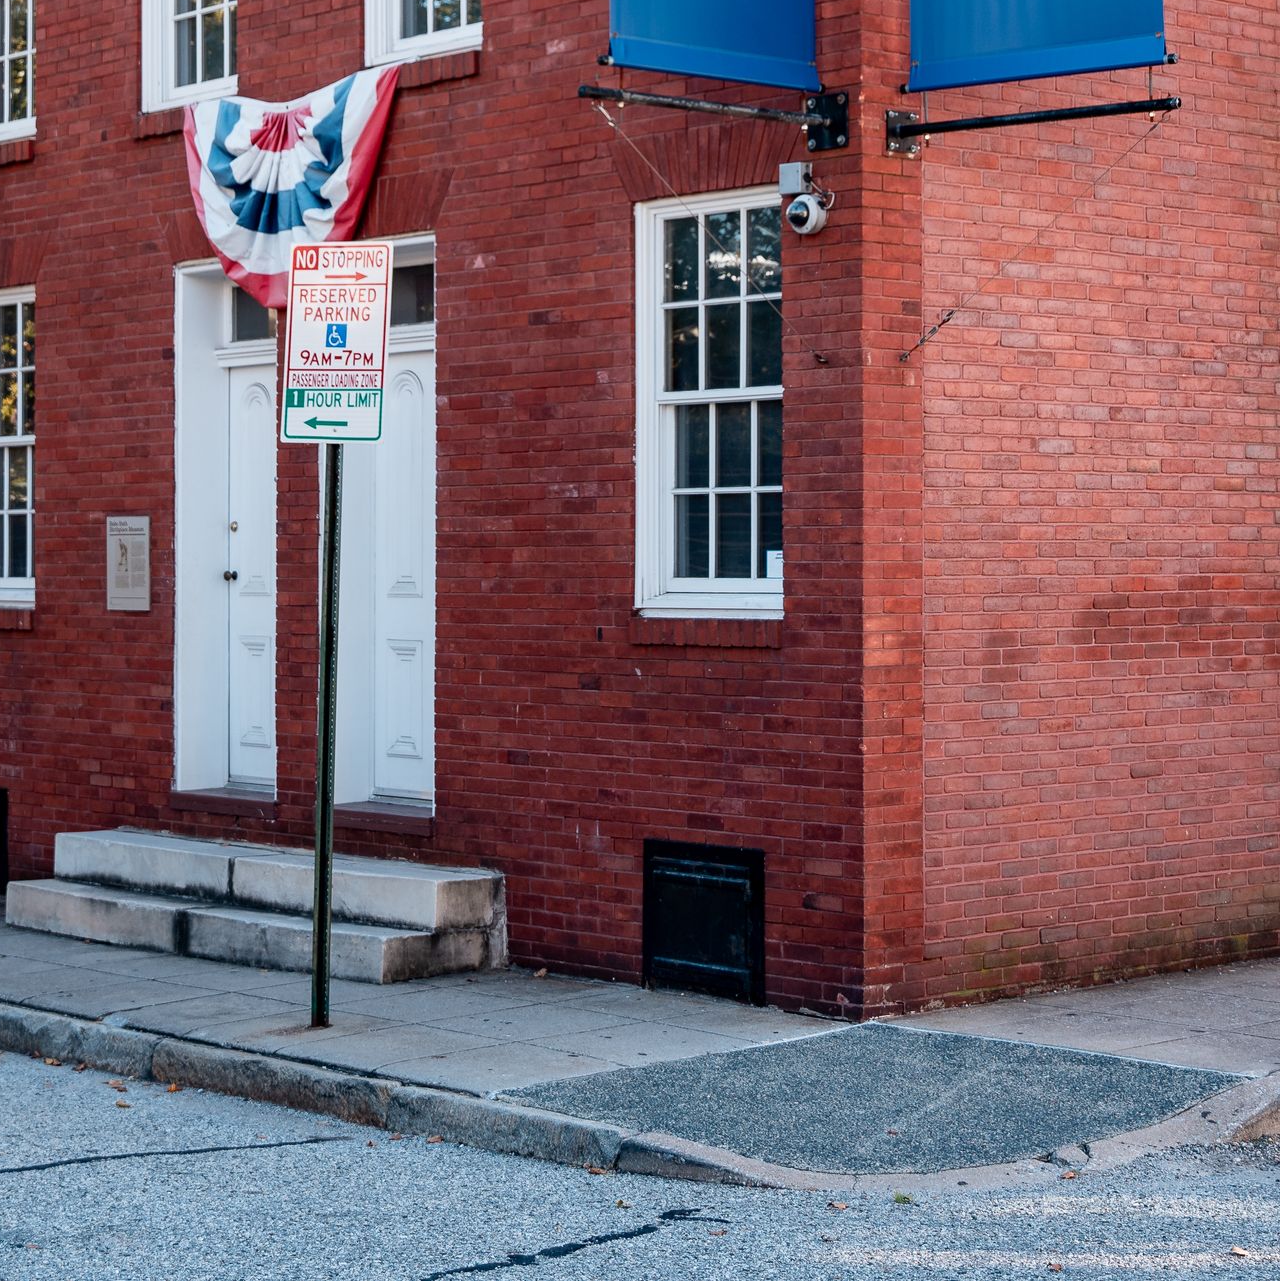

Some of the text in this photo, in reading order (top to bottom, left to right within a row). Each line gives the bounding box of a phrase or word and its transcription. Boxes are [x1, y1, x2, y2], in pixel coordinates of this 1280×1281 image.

[296, 249, 383, 269] NO STOPPING
[299, 288, 377, 303] RESERVED
[303, 306, 371, 322] PARKING
[300, 350, 374, 366] 9AM-7PM
[292, 373, 378, 388] PASSENGER LOADING ZONE
[292, 391, 379, 408] 1 HOUR LIMIT
